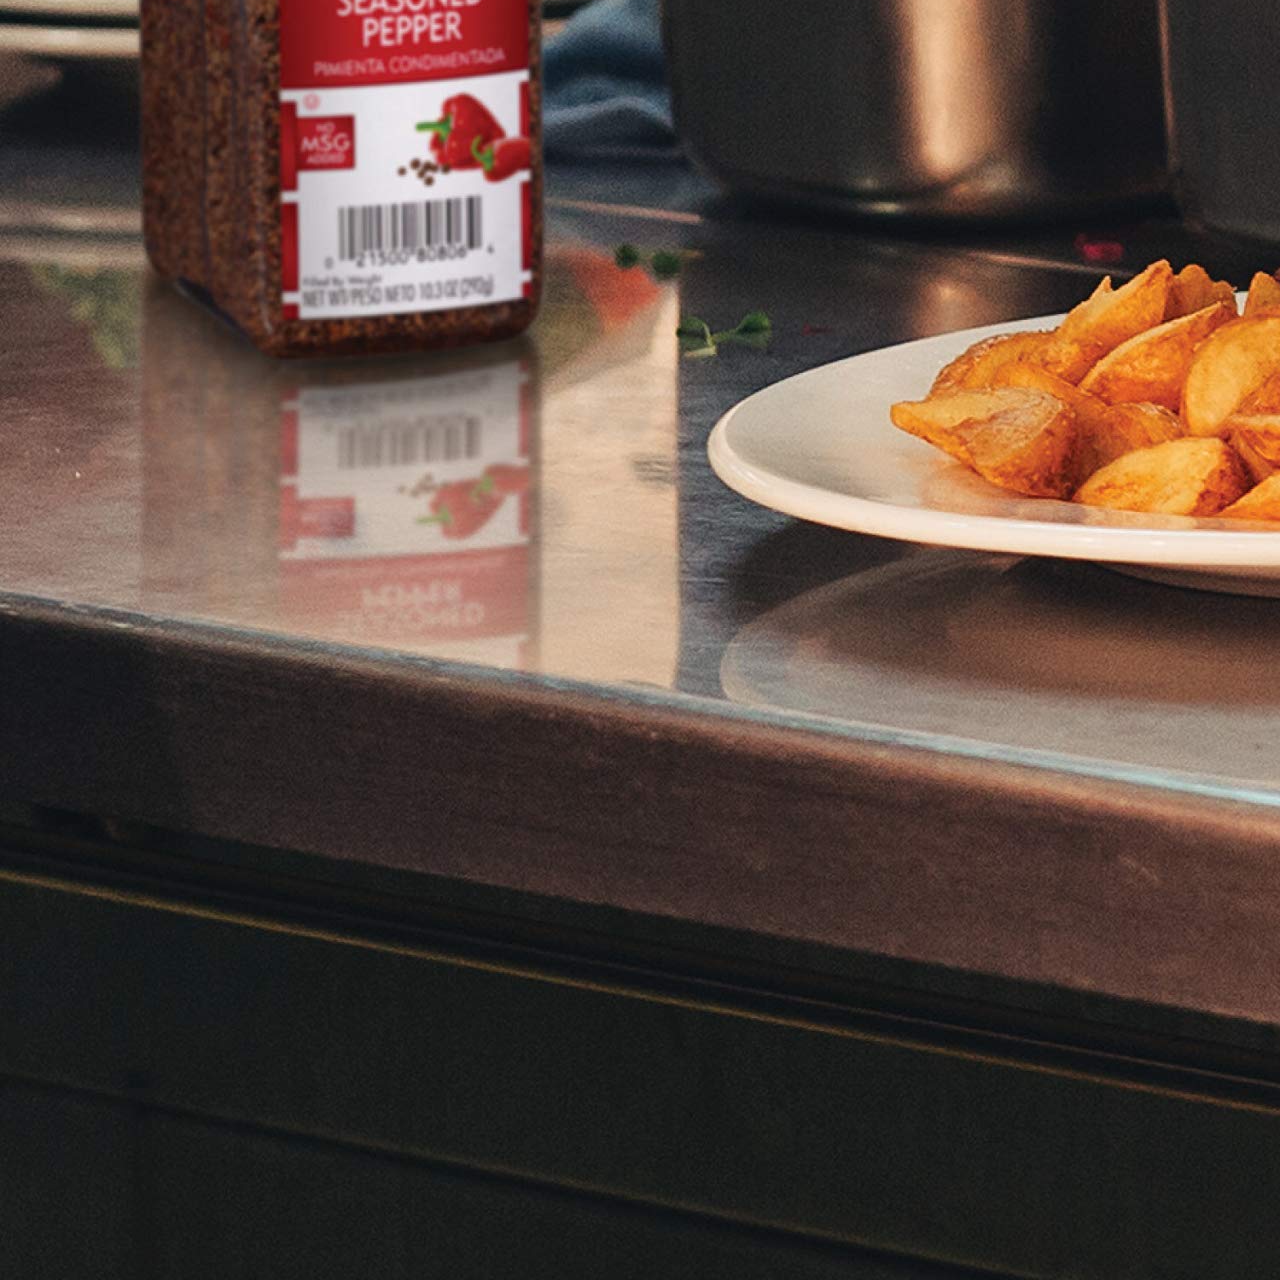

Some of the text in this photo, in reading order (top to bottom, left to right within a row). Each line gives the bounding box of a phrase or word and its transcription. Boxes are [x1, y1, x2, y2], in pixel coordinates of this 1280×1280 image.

[363, 11, 463, 48] PEPPER
[313, 48, 505, 77] PIMIENTA CONDIMENTADA
[302, 133, 350, 153] MSG
